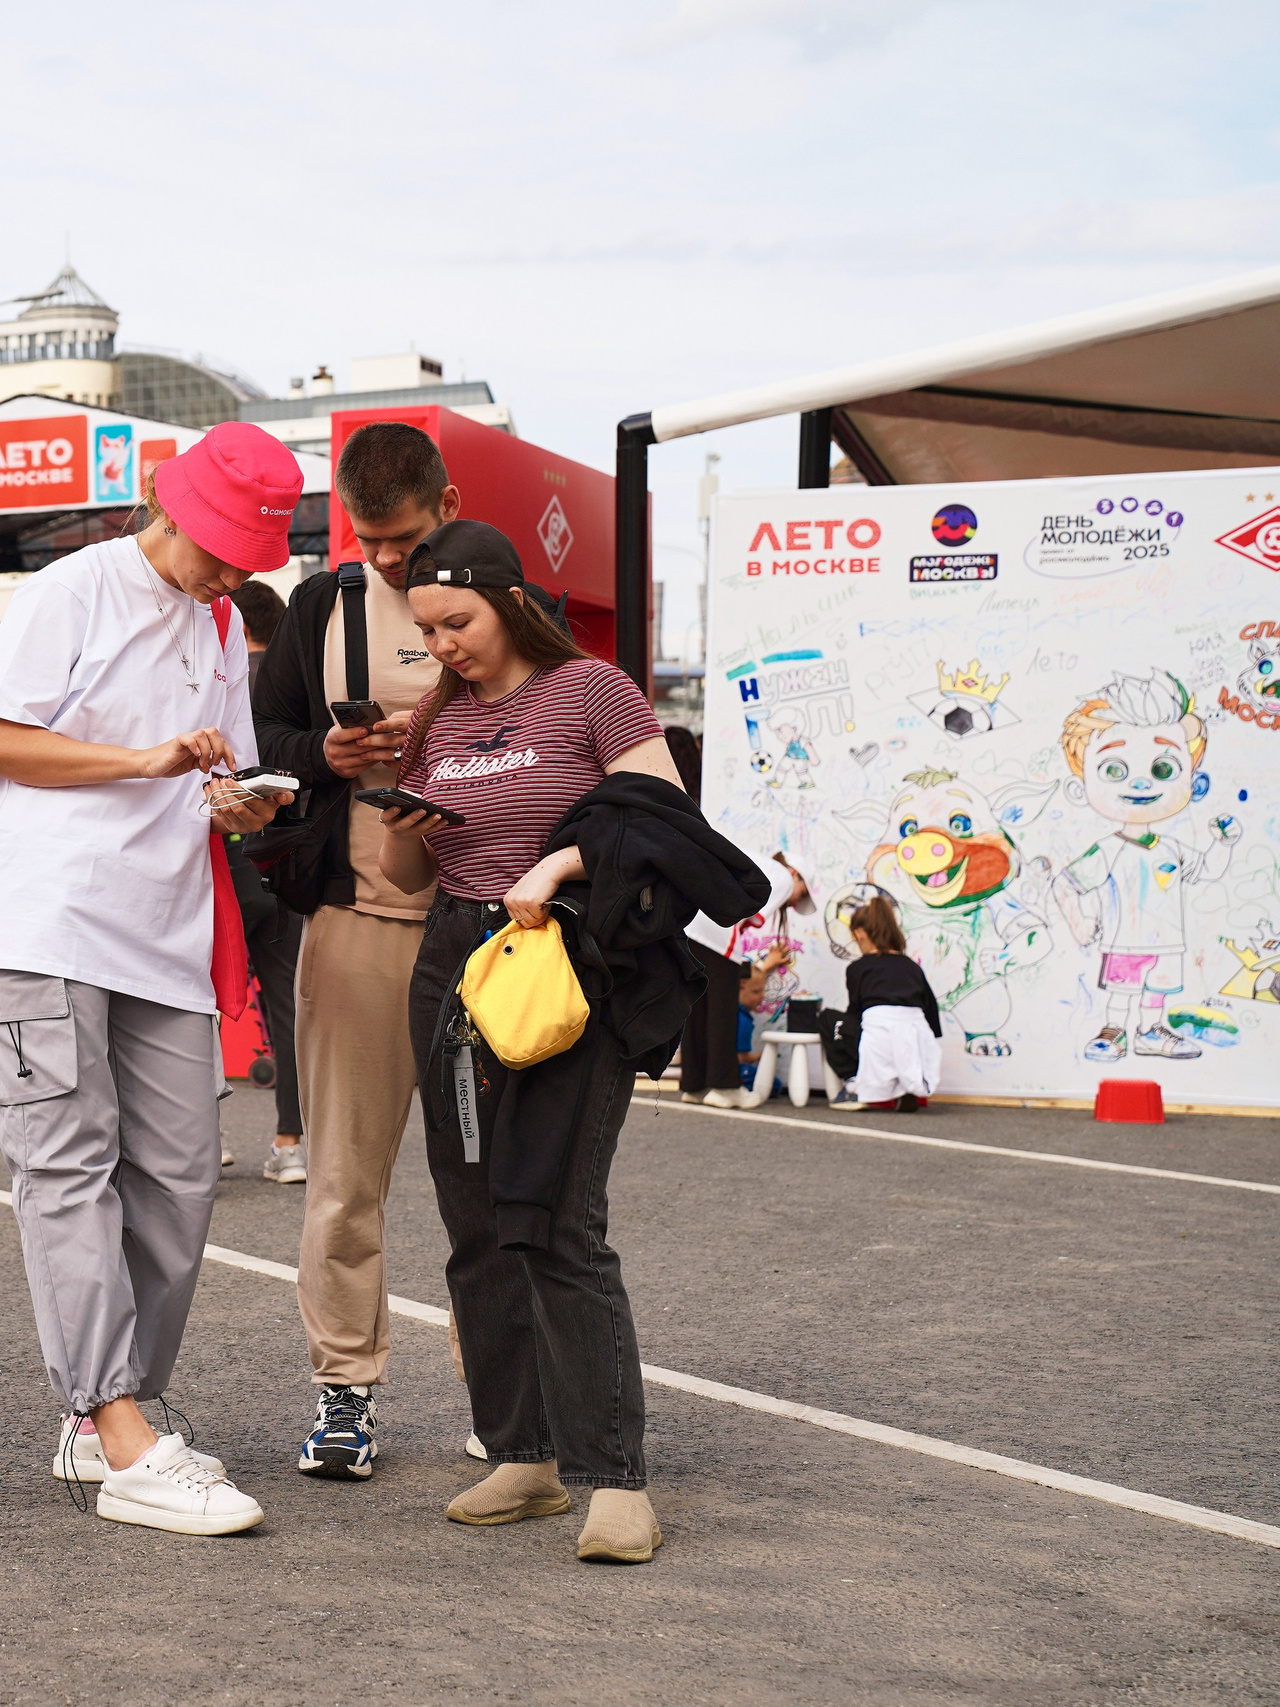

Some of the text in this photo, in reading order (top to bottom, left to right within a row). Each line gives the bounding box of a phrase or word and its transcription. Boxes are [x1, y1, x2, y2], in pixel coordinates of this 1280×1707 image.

[1040, 515, 1094, 531] ДЕНЬ
[748, 518, 882, 552] ЛЕТО
[1040, 526, 1162, 545] МОЛОДЁЖИ
[1123, 543, 1170, 561] 2025
[747, 557, 881, 577] В МОСКВЕ
[913, 566, 995, 582] МОСКВЫ
[397, 649, 429, 659] Reebok
[738, 657, 850, 706] НУЖЕН
[427, 748, 540, 783] Hollister
[458, 1078, 475, 1139] местный
